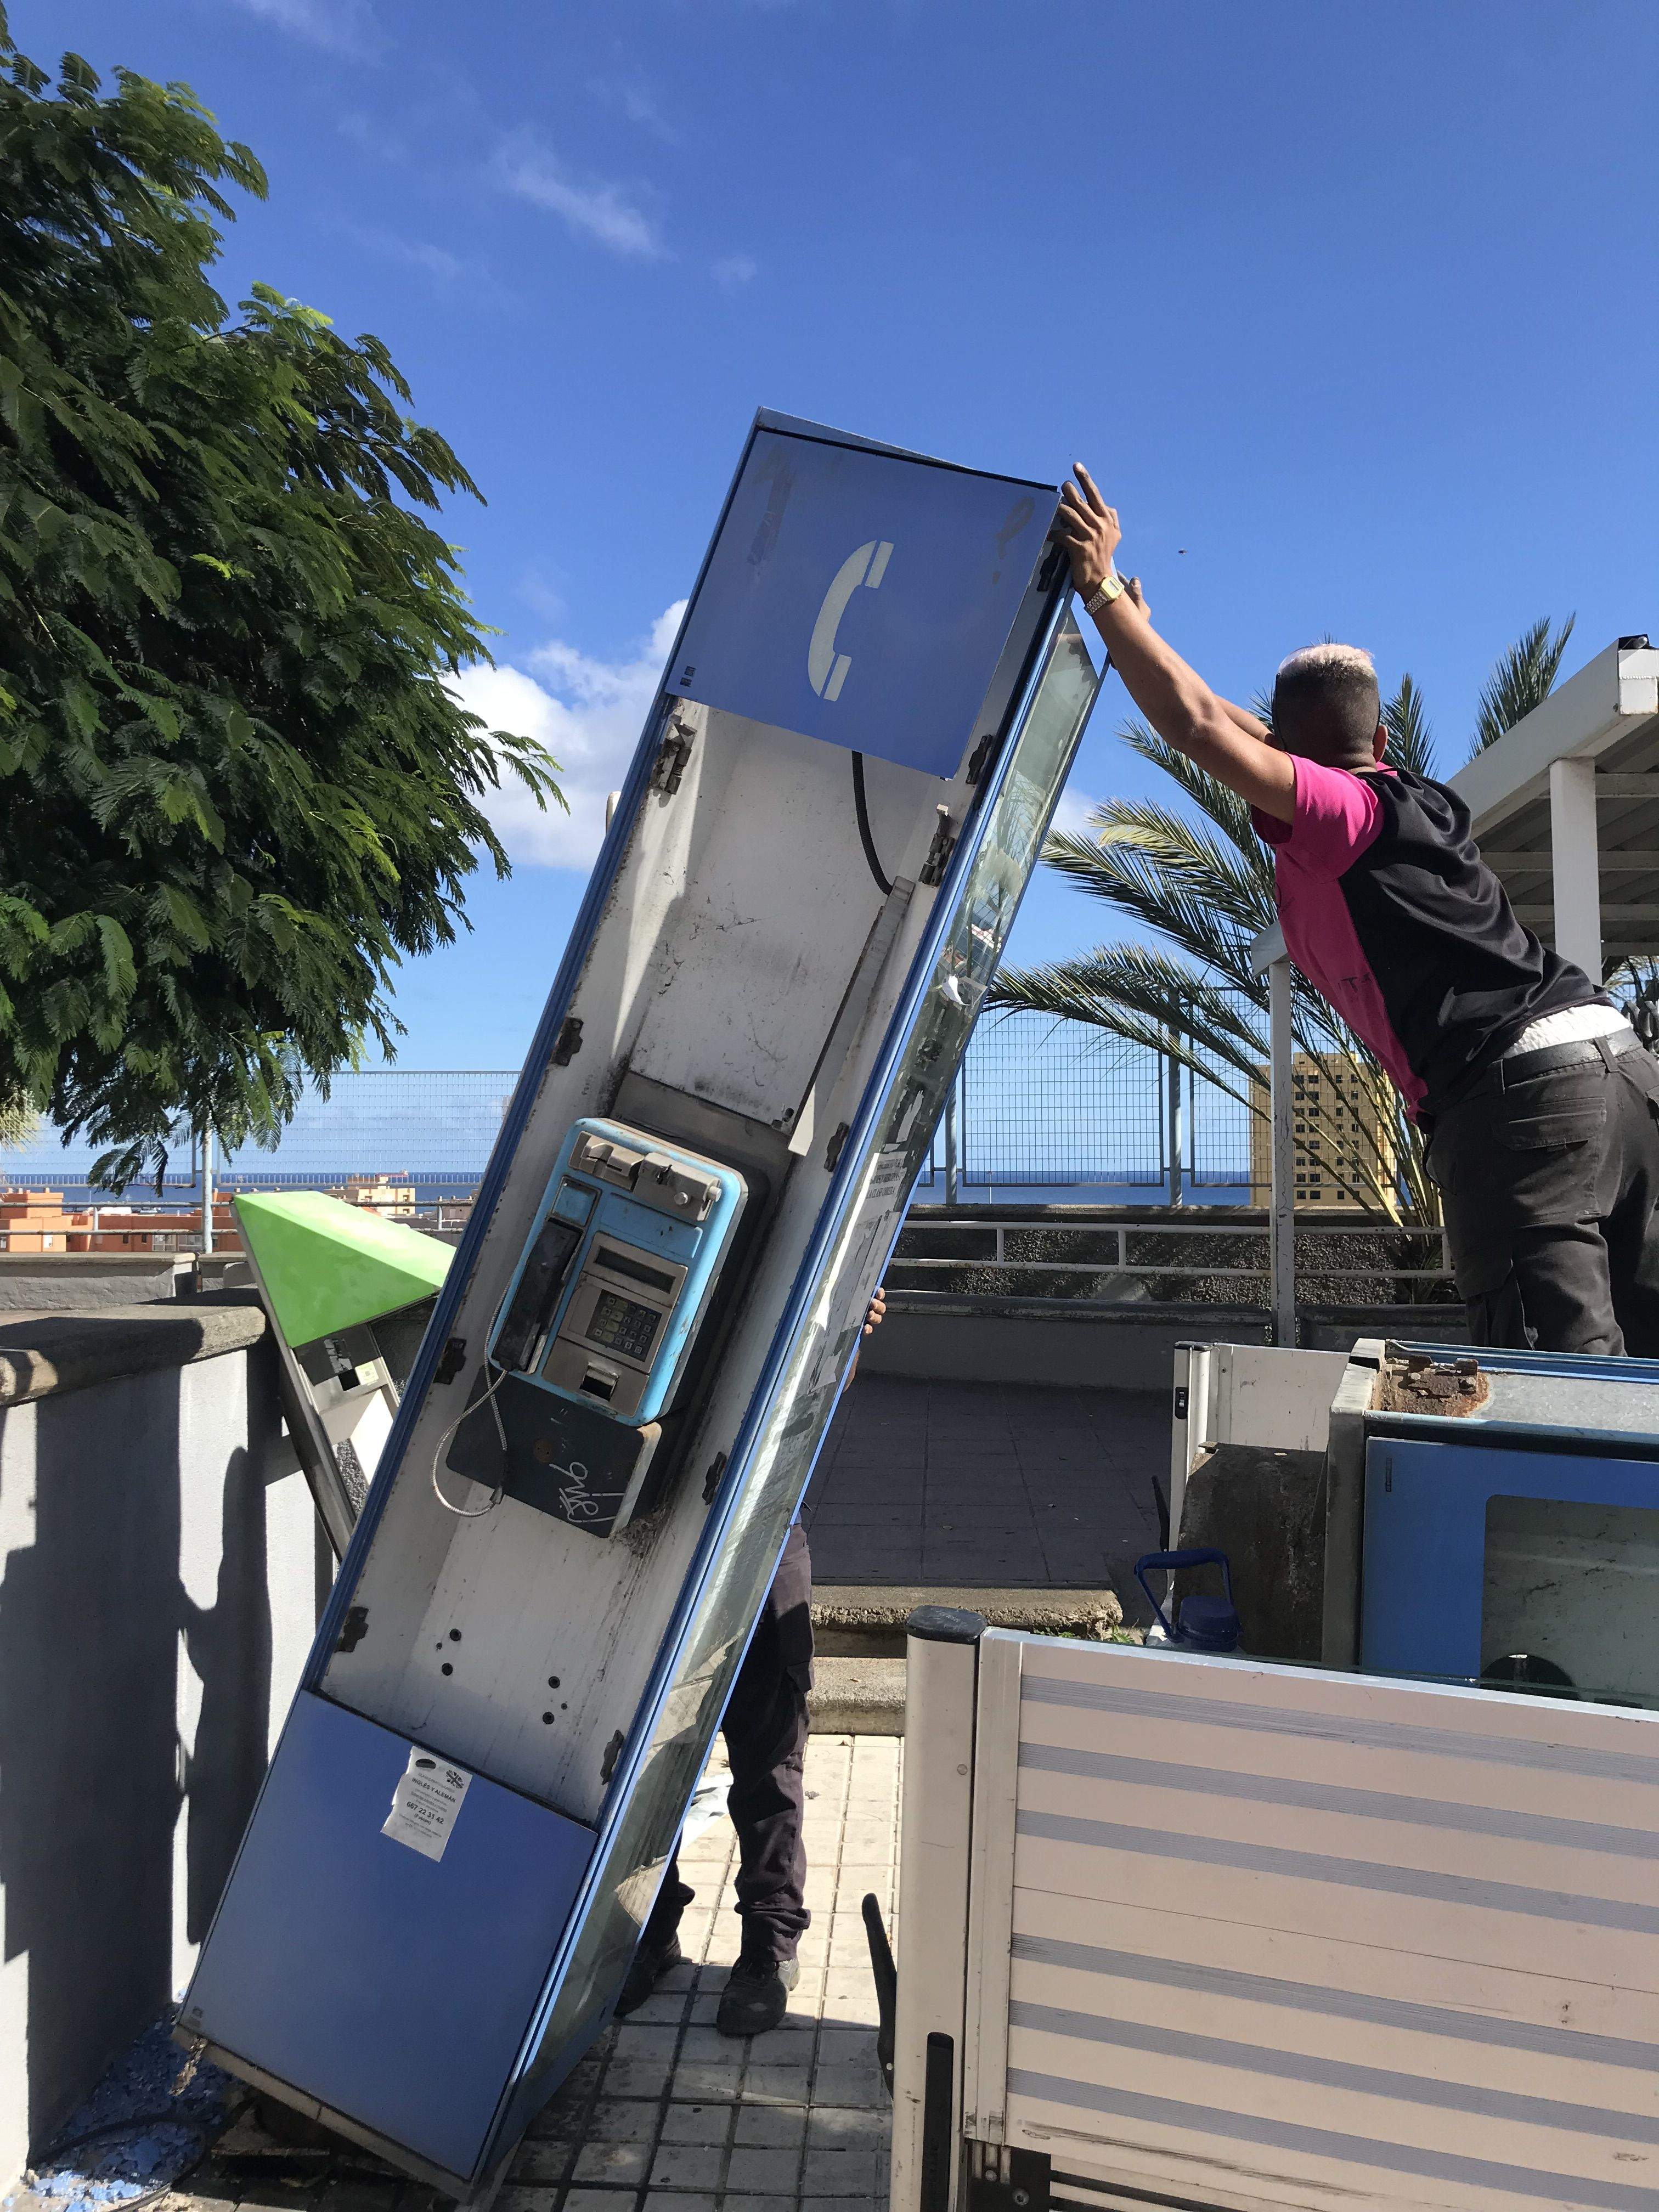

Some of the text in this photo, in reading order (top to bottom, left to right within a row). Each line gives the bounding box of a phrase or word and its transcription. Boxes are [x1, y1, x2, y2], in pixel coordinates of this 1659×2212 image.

[411, 1778, 430, 1790] INGLÉS
[435, 1790, 456, 1803] ALEMÁN
[407, 1801, 418, 1810] 667
[419, 1807, 427, 1815] 22
